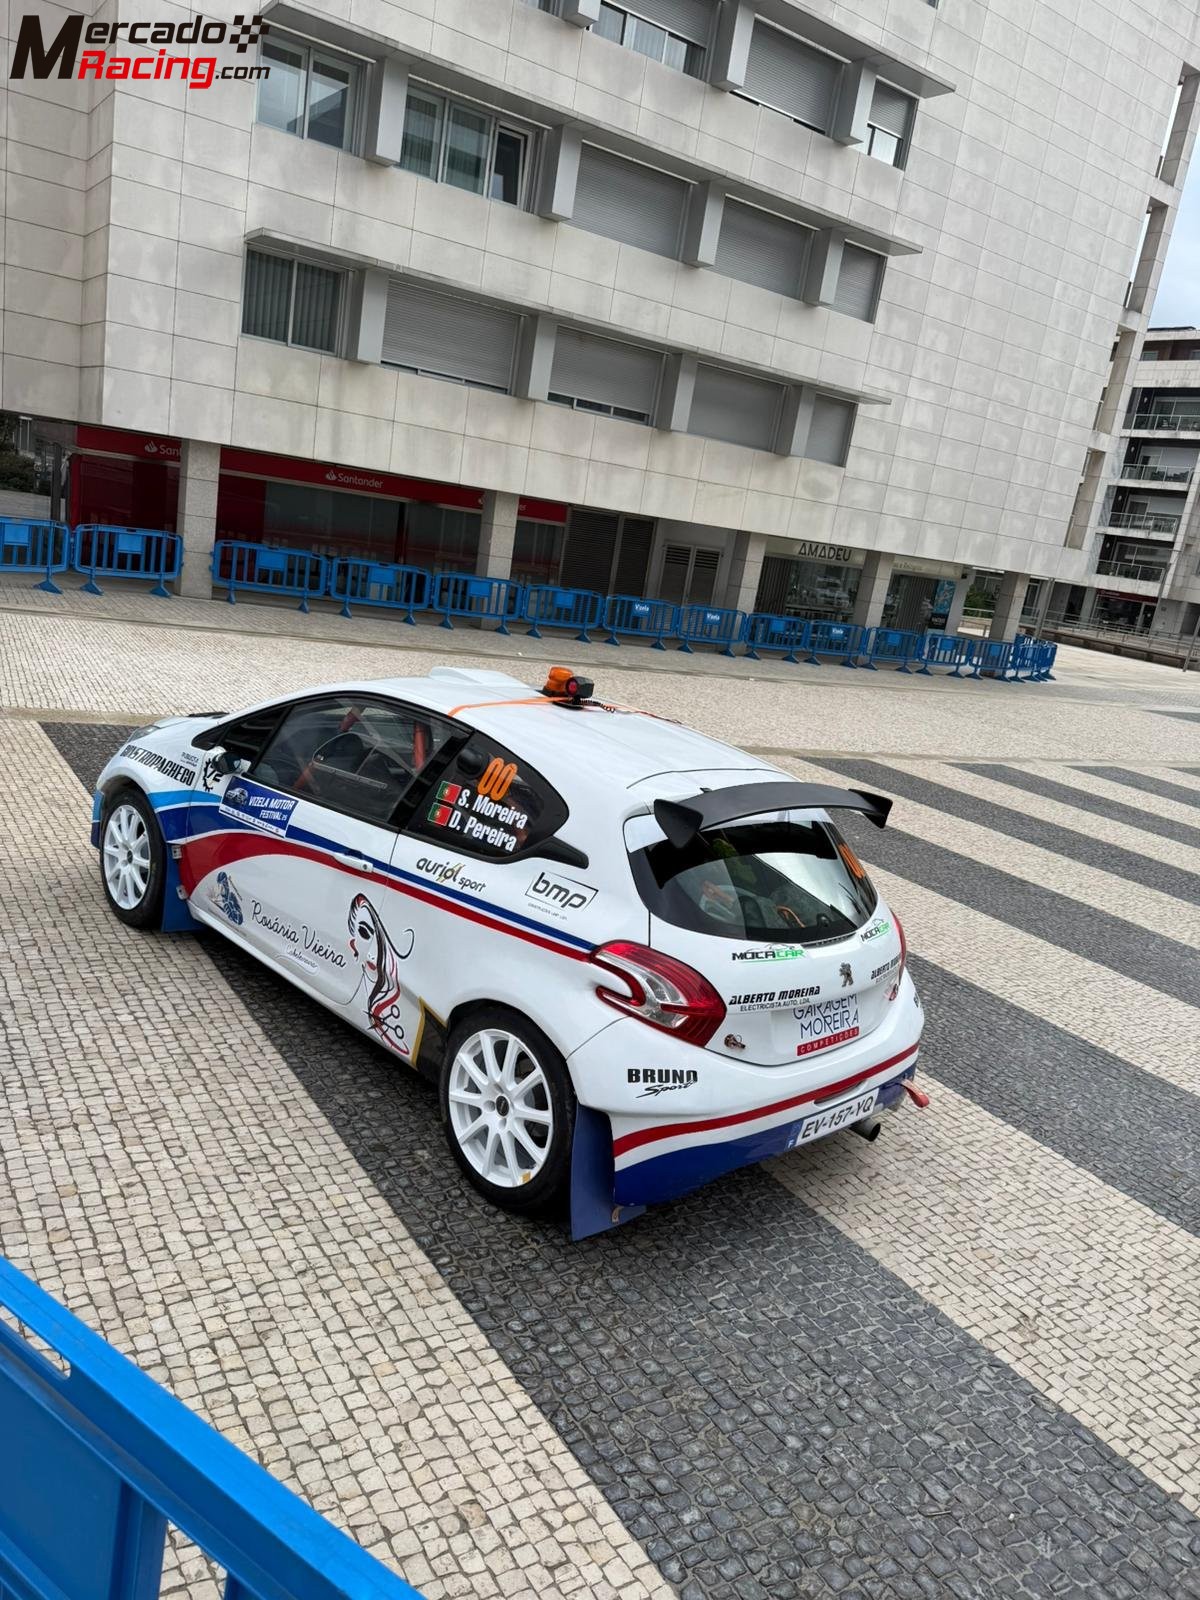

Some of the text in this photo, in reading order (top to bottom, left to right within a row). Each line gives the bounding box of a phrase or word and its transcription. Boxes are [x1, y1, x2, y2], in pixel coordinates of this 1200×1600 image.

[337, 472, 384, 489] Santander
[798, 542, 852, 562] AMADEU
[477, 757, 518, 801] 00
[248, 796, 296, 810] VIZELA MOTOR
[457, 788, 528, 829] S. Moreira
[448, 810, 517, 852] D. Pereira
[416, 857, 487, 892] auriol sport
[532, 871, 588, 909] bmp
[251, 899, 346, 968] Rosária Vieira
[728, 985, 821, 1006] ALBERTO MOREIRA
[740, 1002, 782, 1012] ELECTRICISTA
[792, 993, 858, 1020] GARAGEM
[800, 1008, 859, 1039] MOREIRA
[627, 1068, 698, 1083] BRUNO
[635, 1079, 698, 1098] Sport
[801, 1095, 874, 1139] EV-157-YQ
